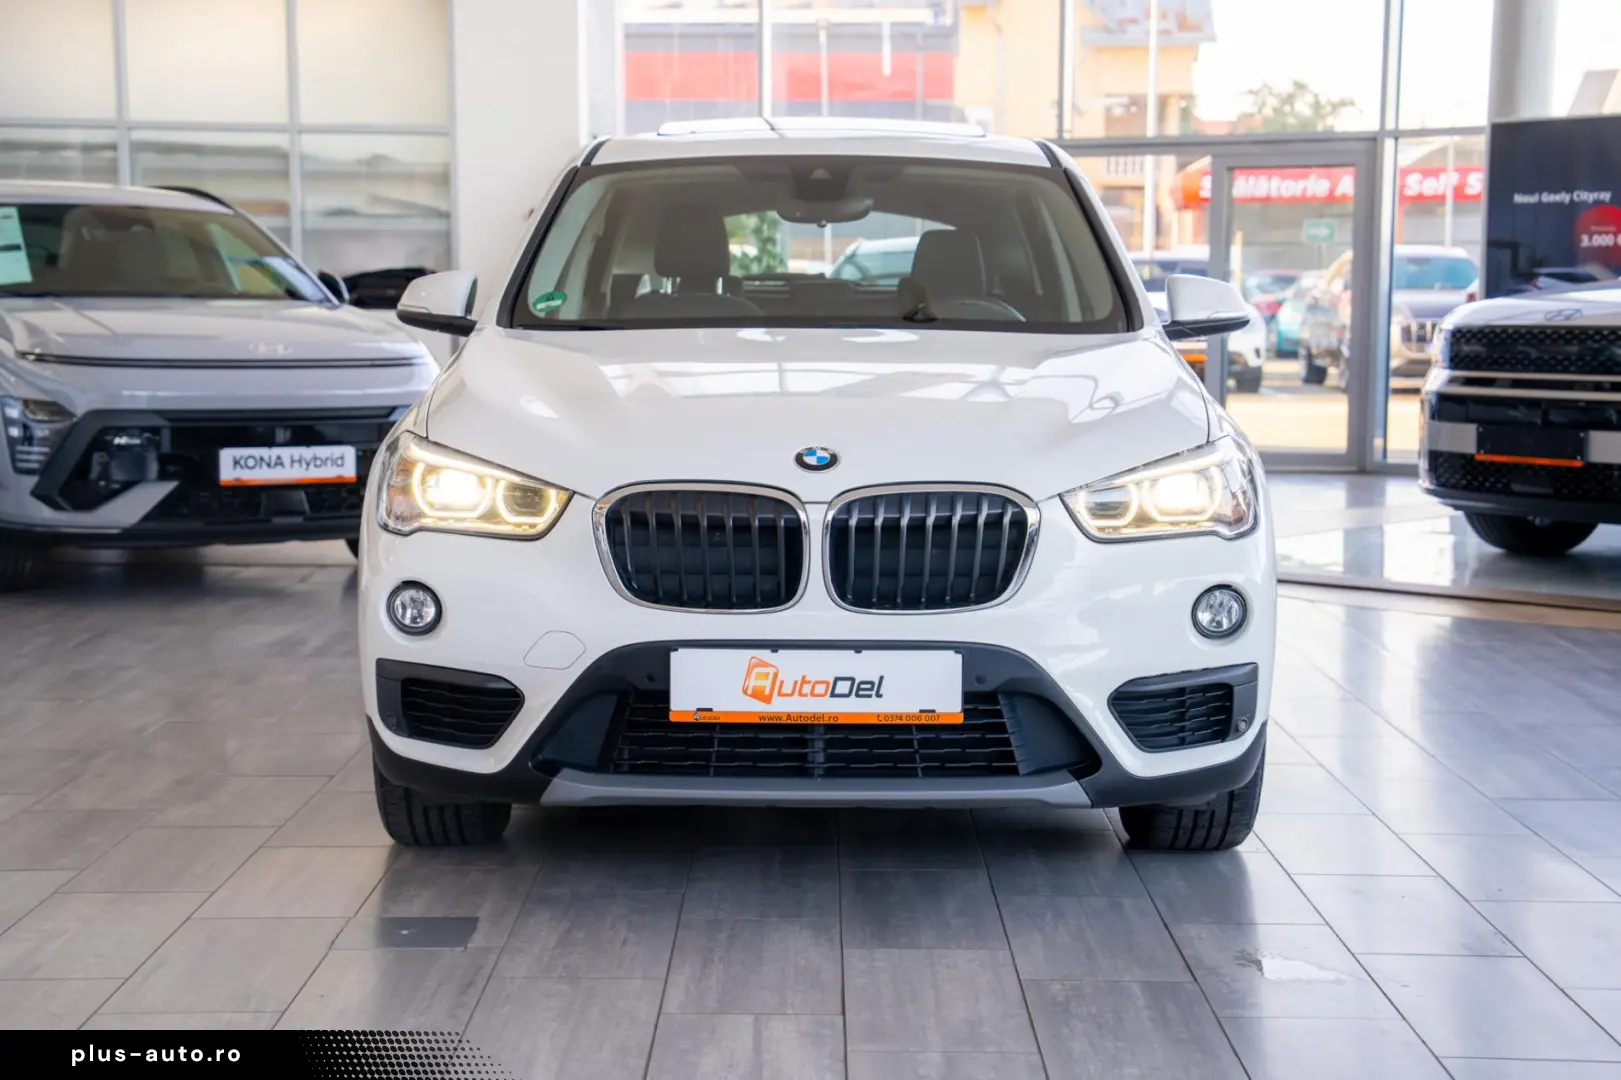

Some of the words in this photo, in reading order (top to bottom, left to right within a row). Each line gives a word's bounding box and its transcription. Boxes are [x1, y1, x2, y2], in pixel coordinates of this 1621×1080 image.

[233, 454, 286, 470] KONA
[290, 452, 345, 471] Hybrid
[743, 659, 885, 703] AutoDel
[758, 713, 839, 723] www.Autodel.ro
[883, 714, 903, 722] 0374
